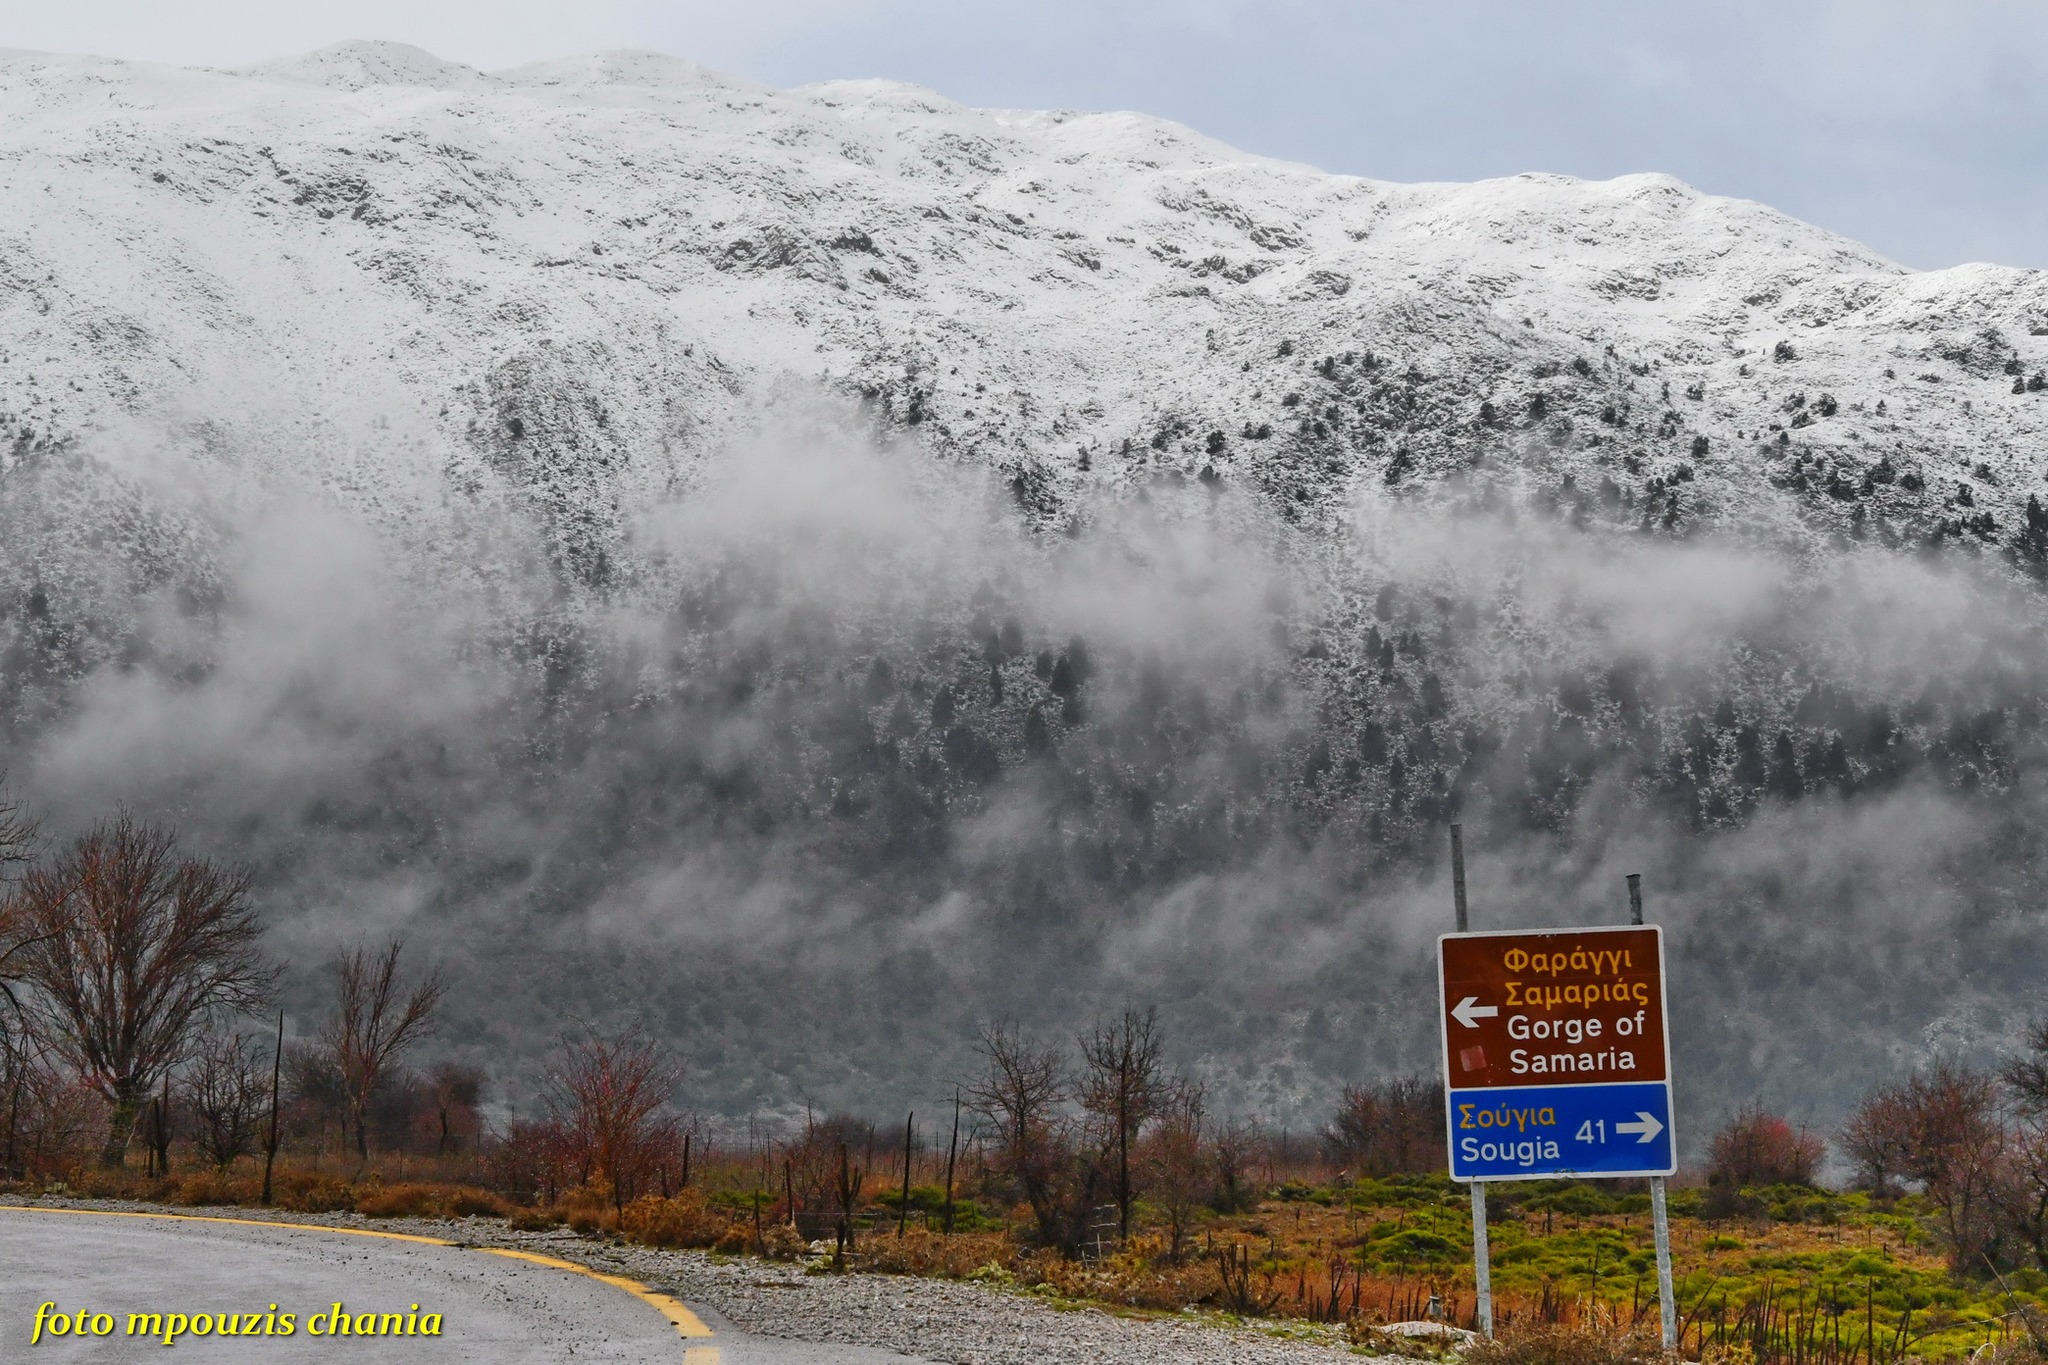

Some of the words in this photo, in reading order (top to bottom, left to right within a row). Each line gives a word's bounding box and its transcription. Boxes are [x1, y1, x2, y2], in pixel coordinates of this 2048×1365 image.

[1503, 945, 1632, 977] Φαράγγι
[1504, 978, 1649, 1011] Σαμαριάς
[1507, 1014, 1603, 1044] Gorge
[1615, 1010, 1645, 1036] of
[1509, 1046, 1636, 1074] Samaria
[1458, 1102, 1556, 1132] Σούγια
[1575, 1119, 1606, 1144] 41
[1460, 1135, 1560, 1167] Sougia
